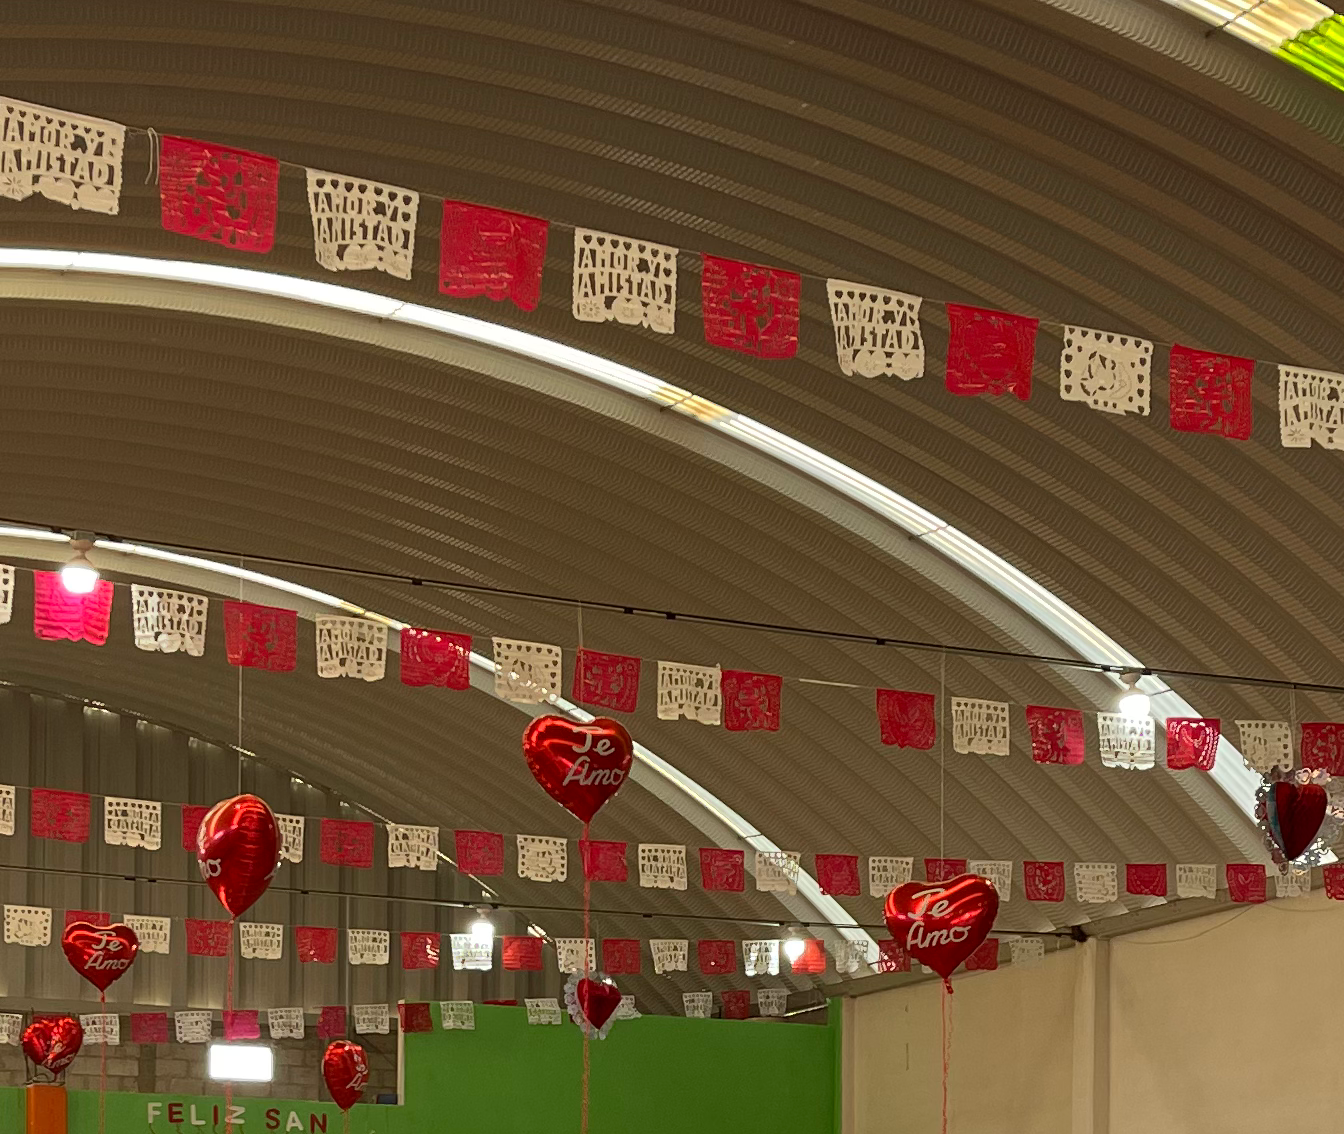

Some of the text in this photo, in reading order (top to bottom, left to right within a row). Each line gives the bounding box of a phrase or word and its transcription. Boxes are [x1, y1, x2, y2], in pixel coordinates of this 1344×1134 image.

[579, 248, 640, 274] AMOR
[578, 272, 669, 301] AMISTAD
[572, 727, 616, 756] Te
[563, 756, 624, 787] Amo
[908, 889, 953, 920] Te
[91, 931, 122, 950] Te
[907, 920, 972, 950] Amo
[84, 951, 130, 970] Amo
[147, 1102, 328, 1133] FELIZ SAN
